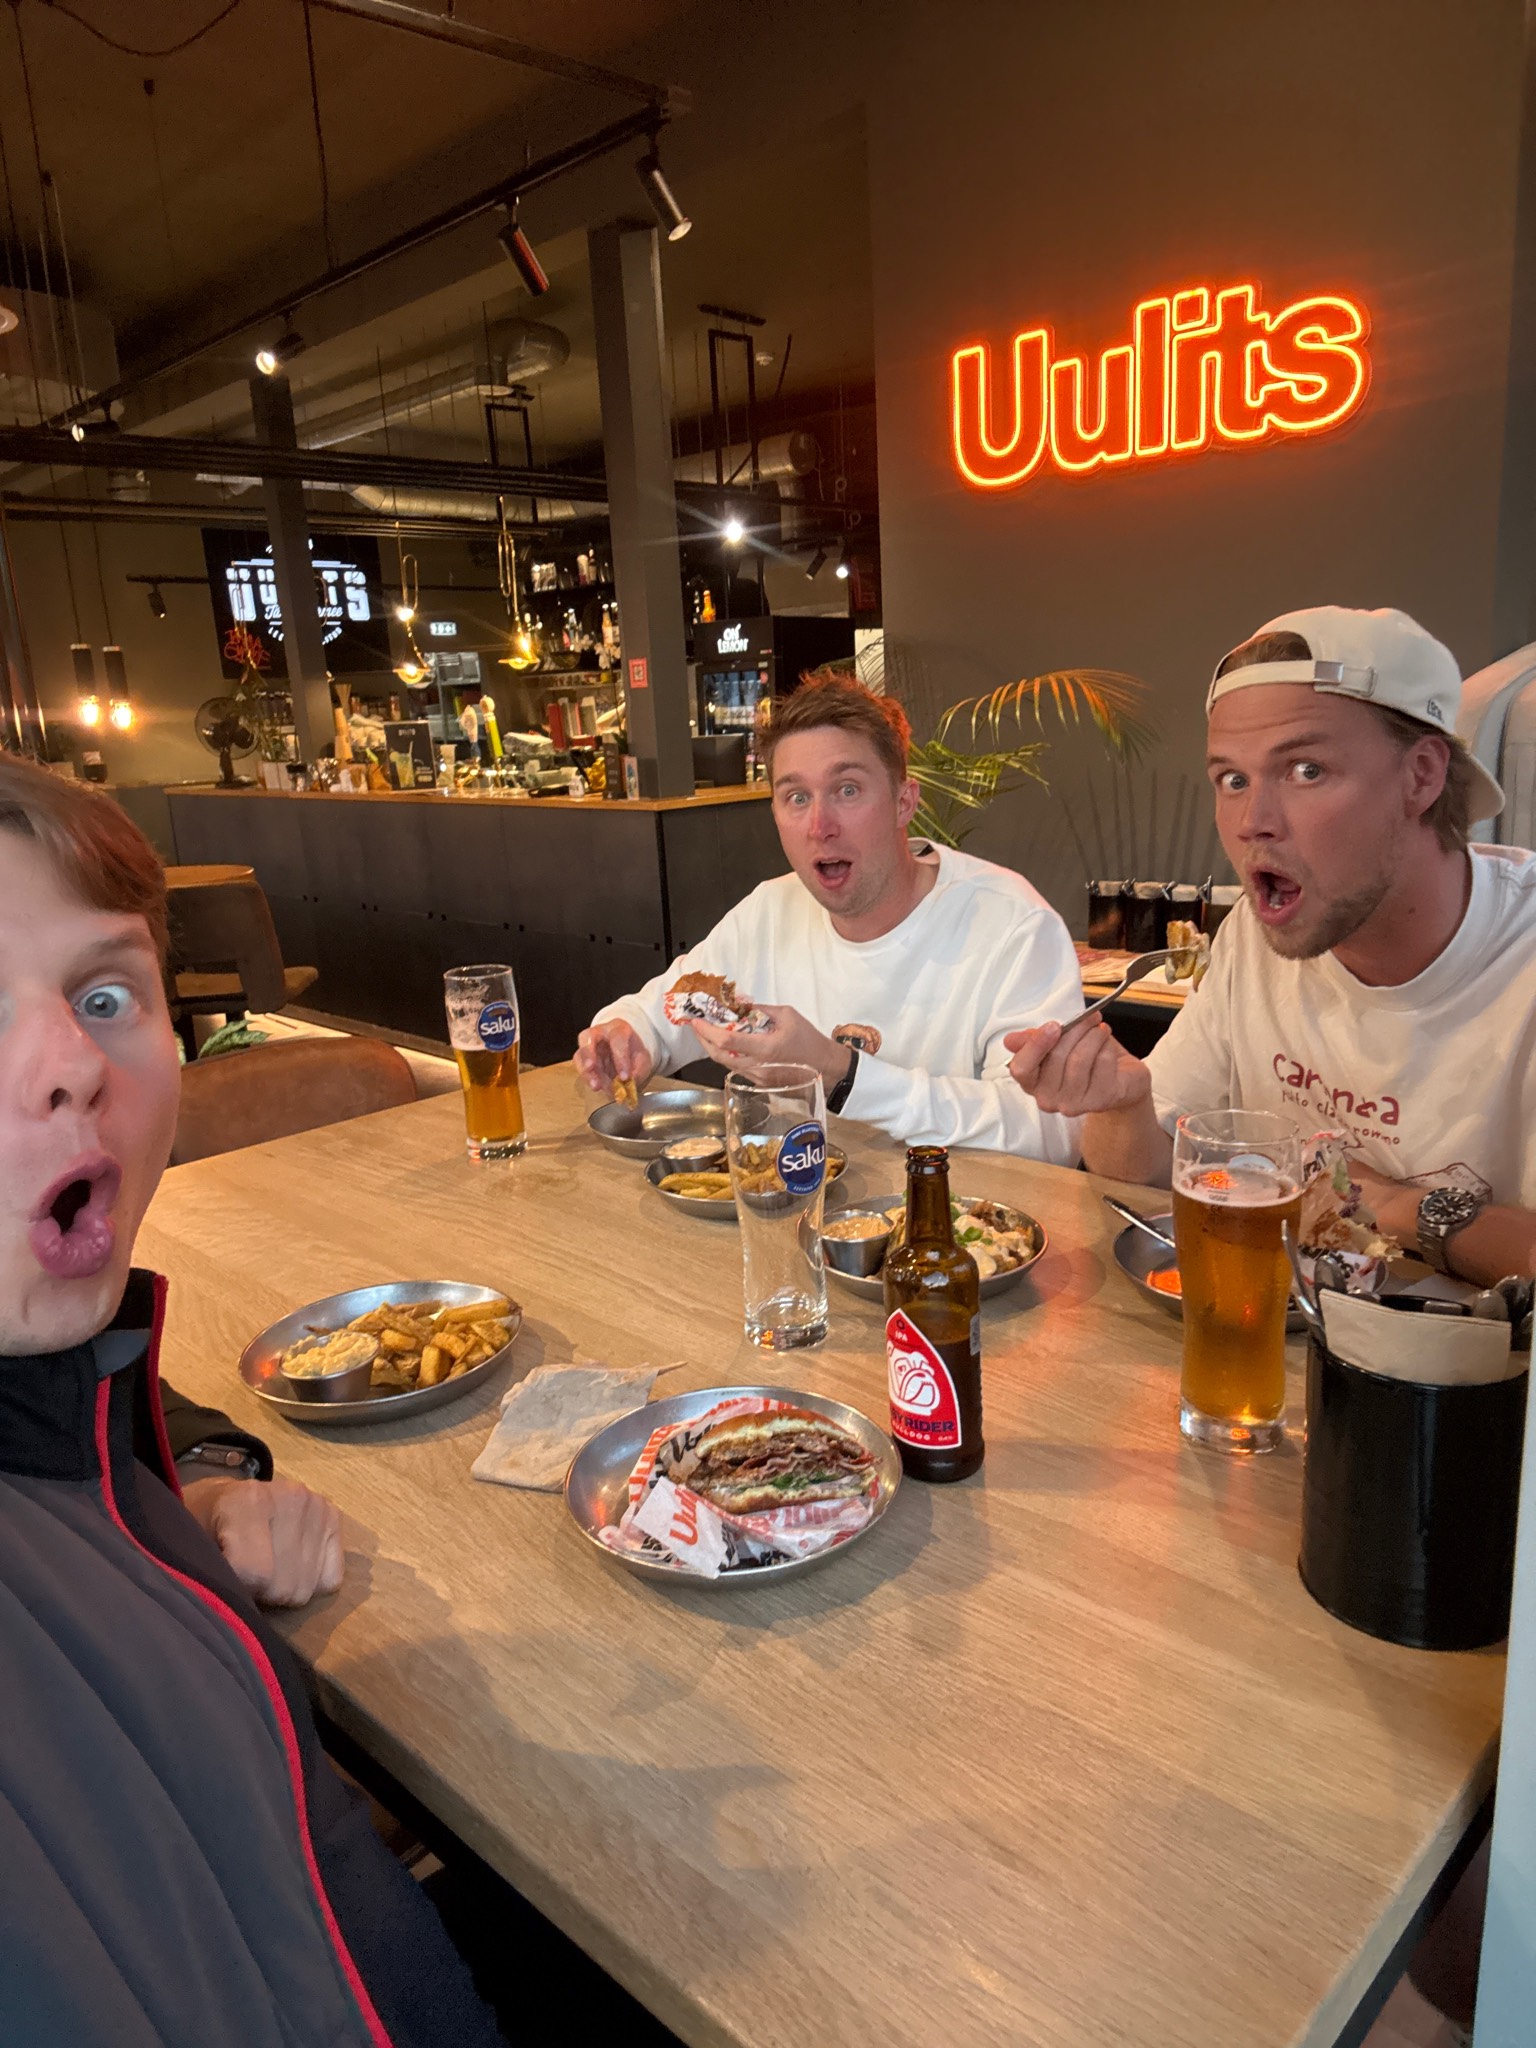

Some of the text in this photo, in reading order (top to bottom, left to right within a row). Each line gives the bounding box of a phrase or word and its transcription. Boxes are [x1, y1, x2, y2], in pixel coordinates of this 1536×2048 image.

[950, 283, 1366, 489] Uulits
[723, 623, 742, 641] ON
[480, 1015, 515, 1036] saku
[781, 1143, 826, 1173] saku
[895, 1329, 909, 1342] IPA
[904, 1417, 955, 1433] RIDER
